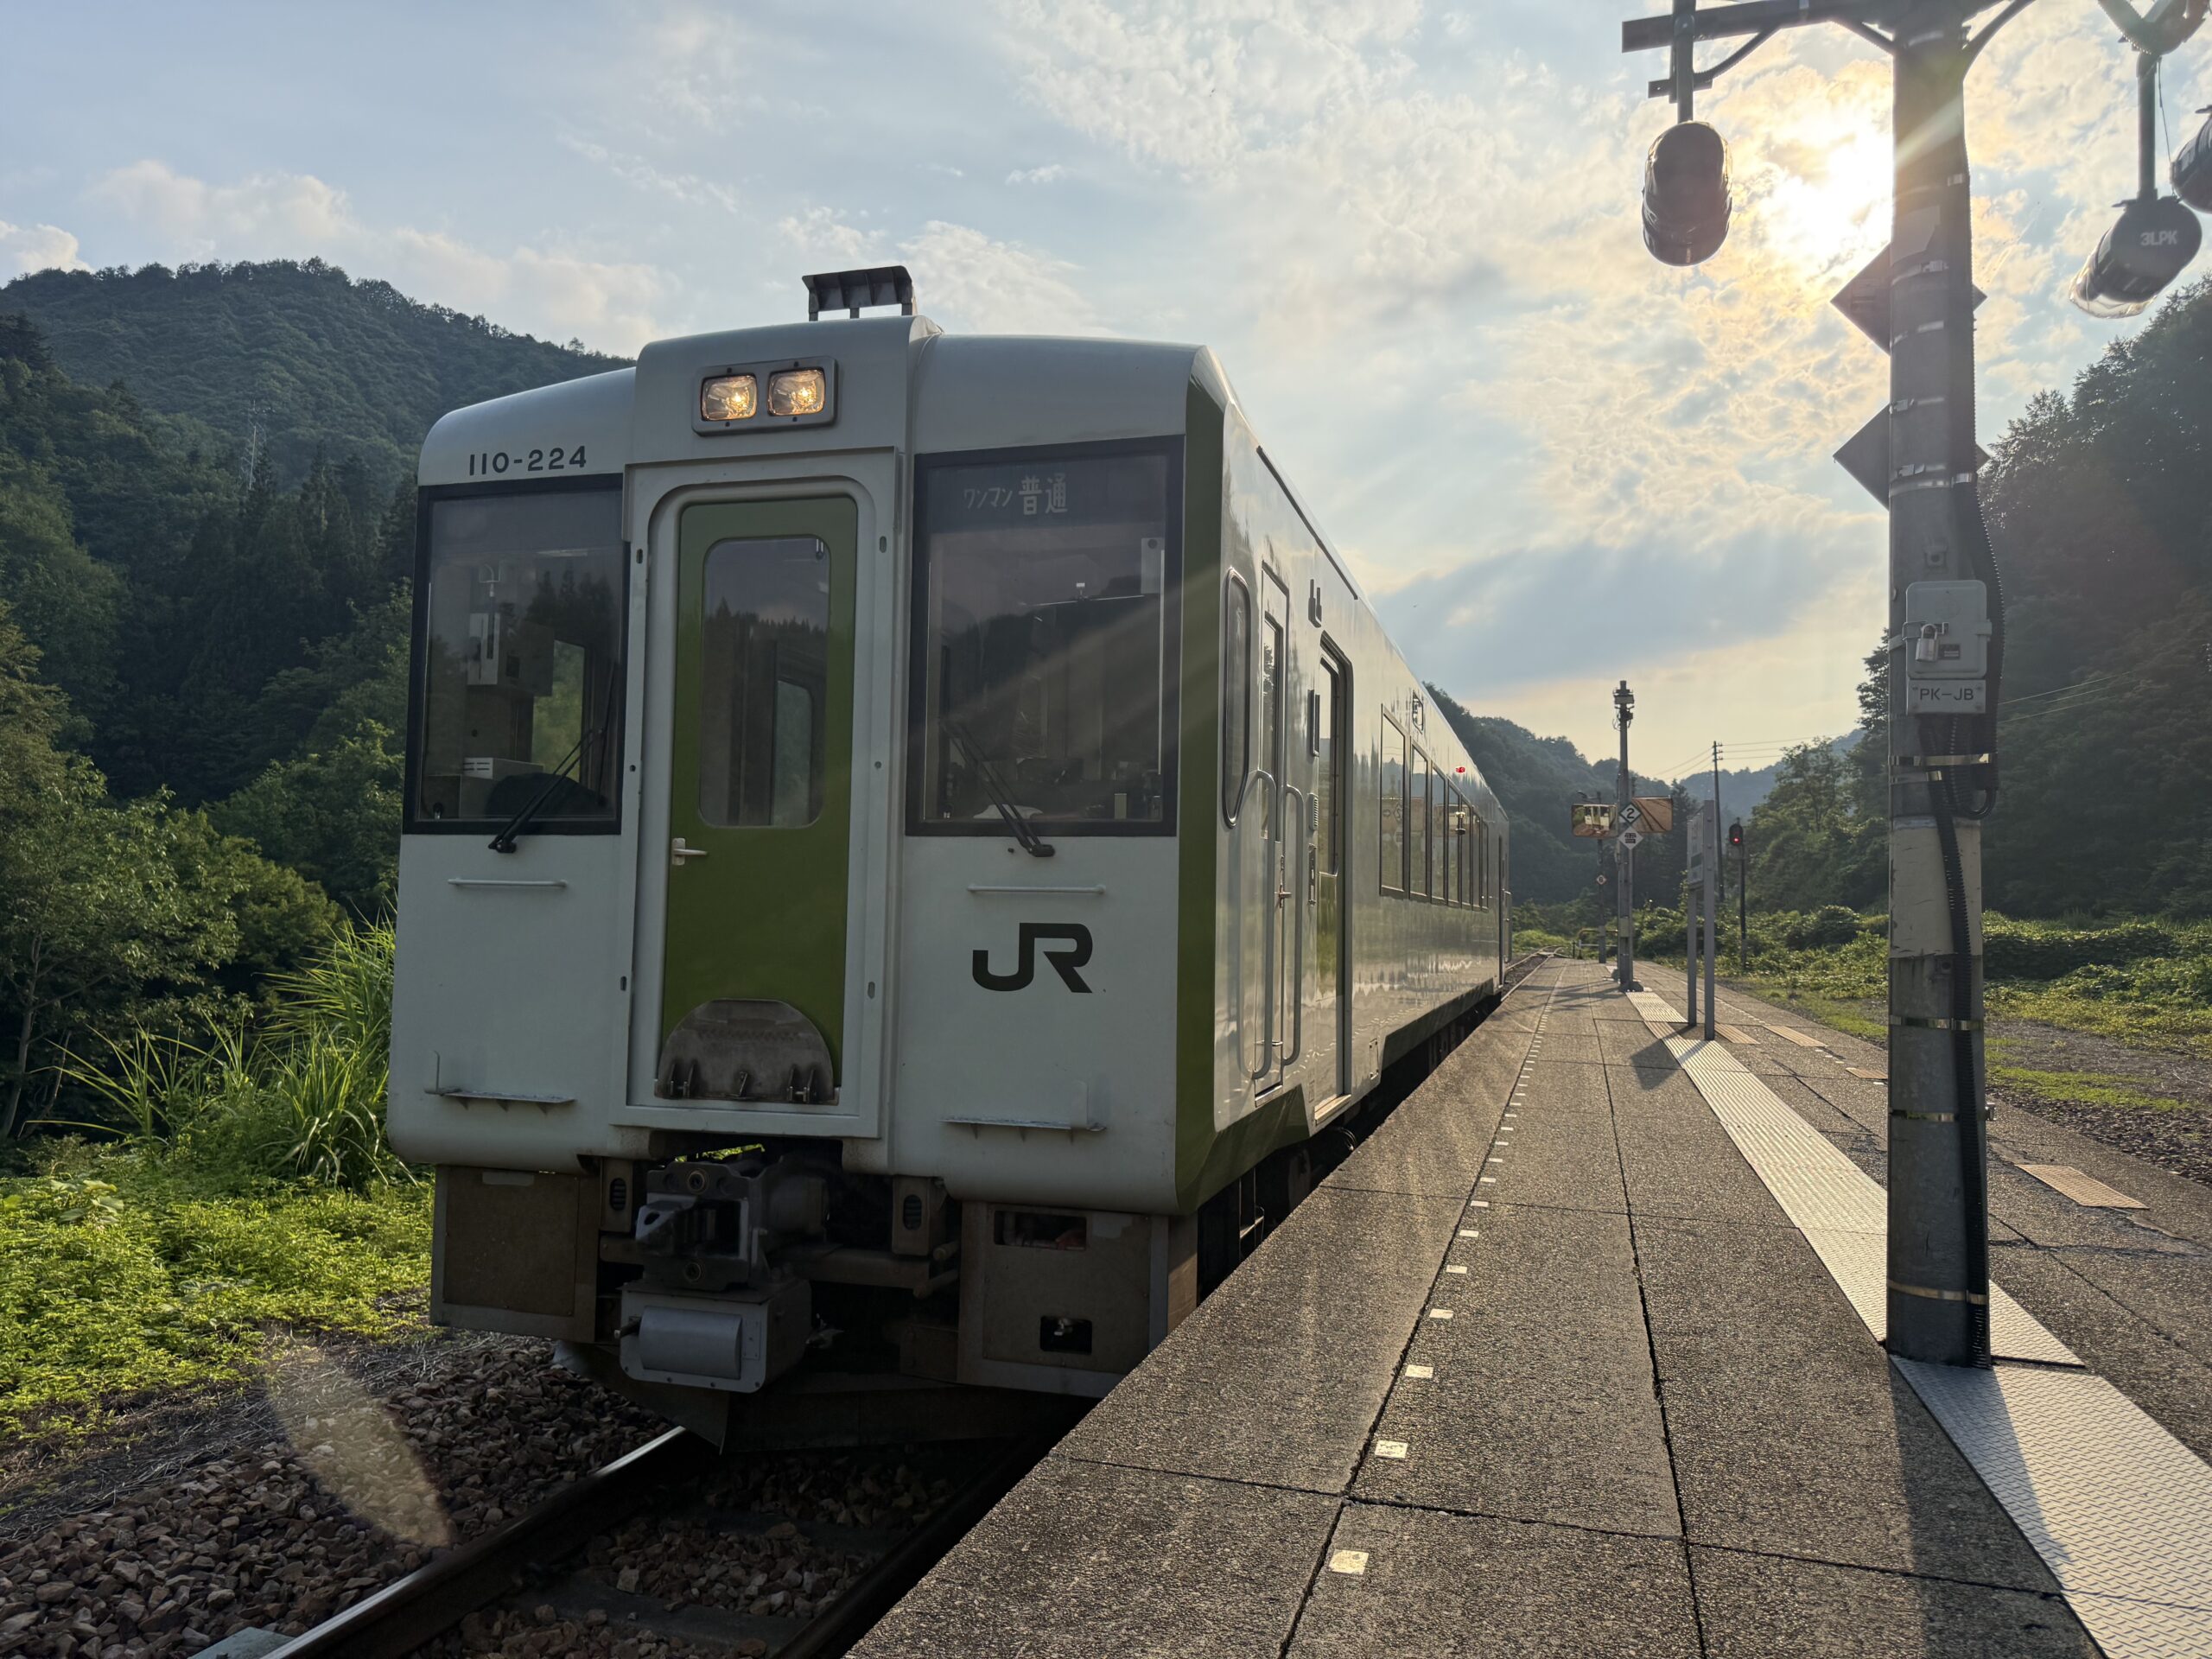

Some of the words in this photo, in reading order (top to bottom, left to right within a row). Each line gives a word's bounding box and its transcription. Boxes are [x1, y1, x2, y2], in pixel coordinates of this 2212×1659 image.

[469, 445, 587, 476] 110-224
[963, 486, 1013, 509] ワンマン
[1019, 473, 1069, 516] 普通
[1920, 688, 1974, 701] PK-JB
[1626, 808, 1635, 819] 2
[971, 922, 1094, 994] JR
